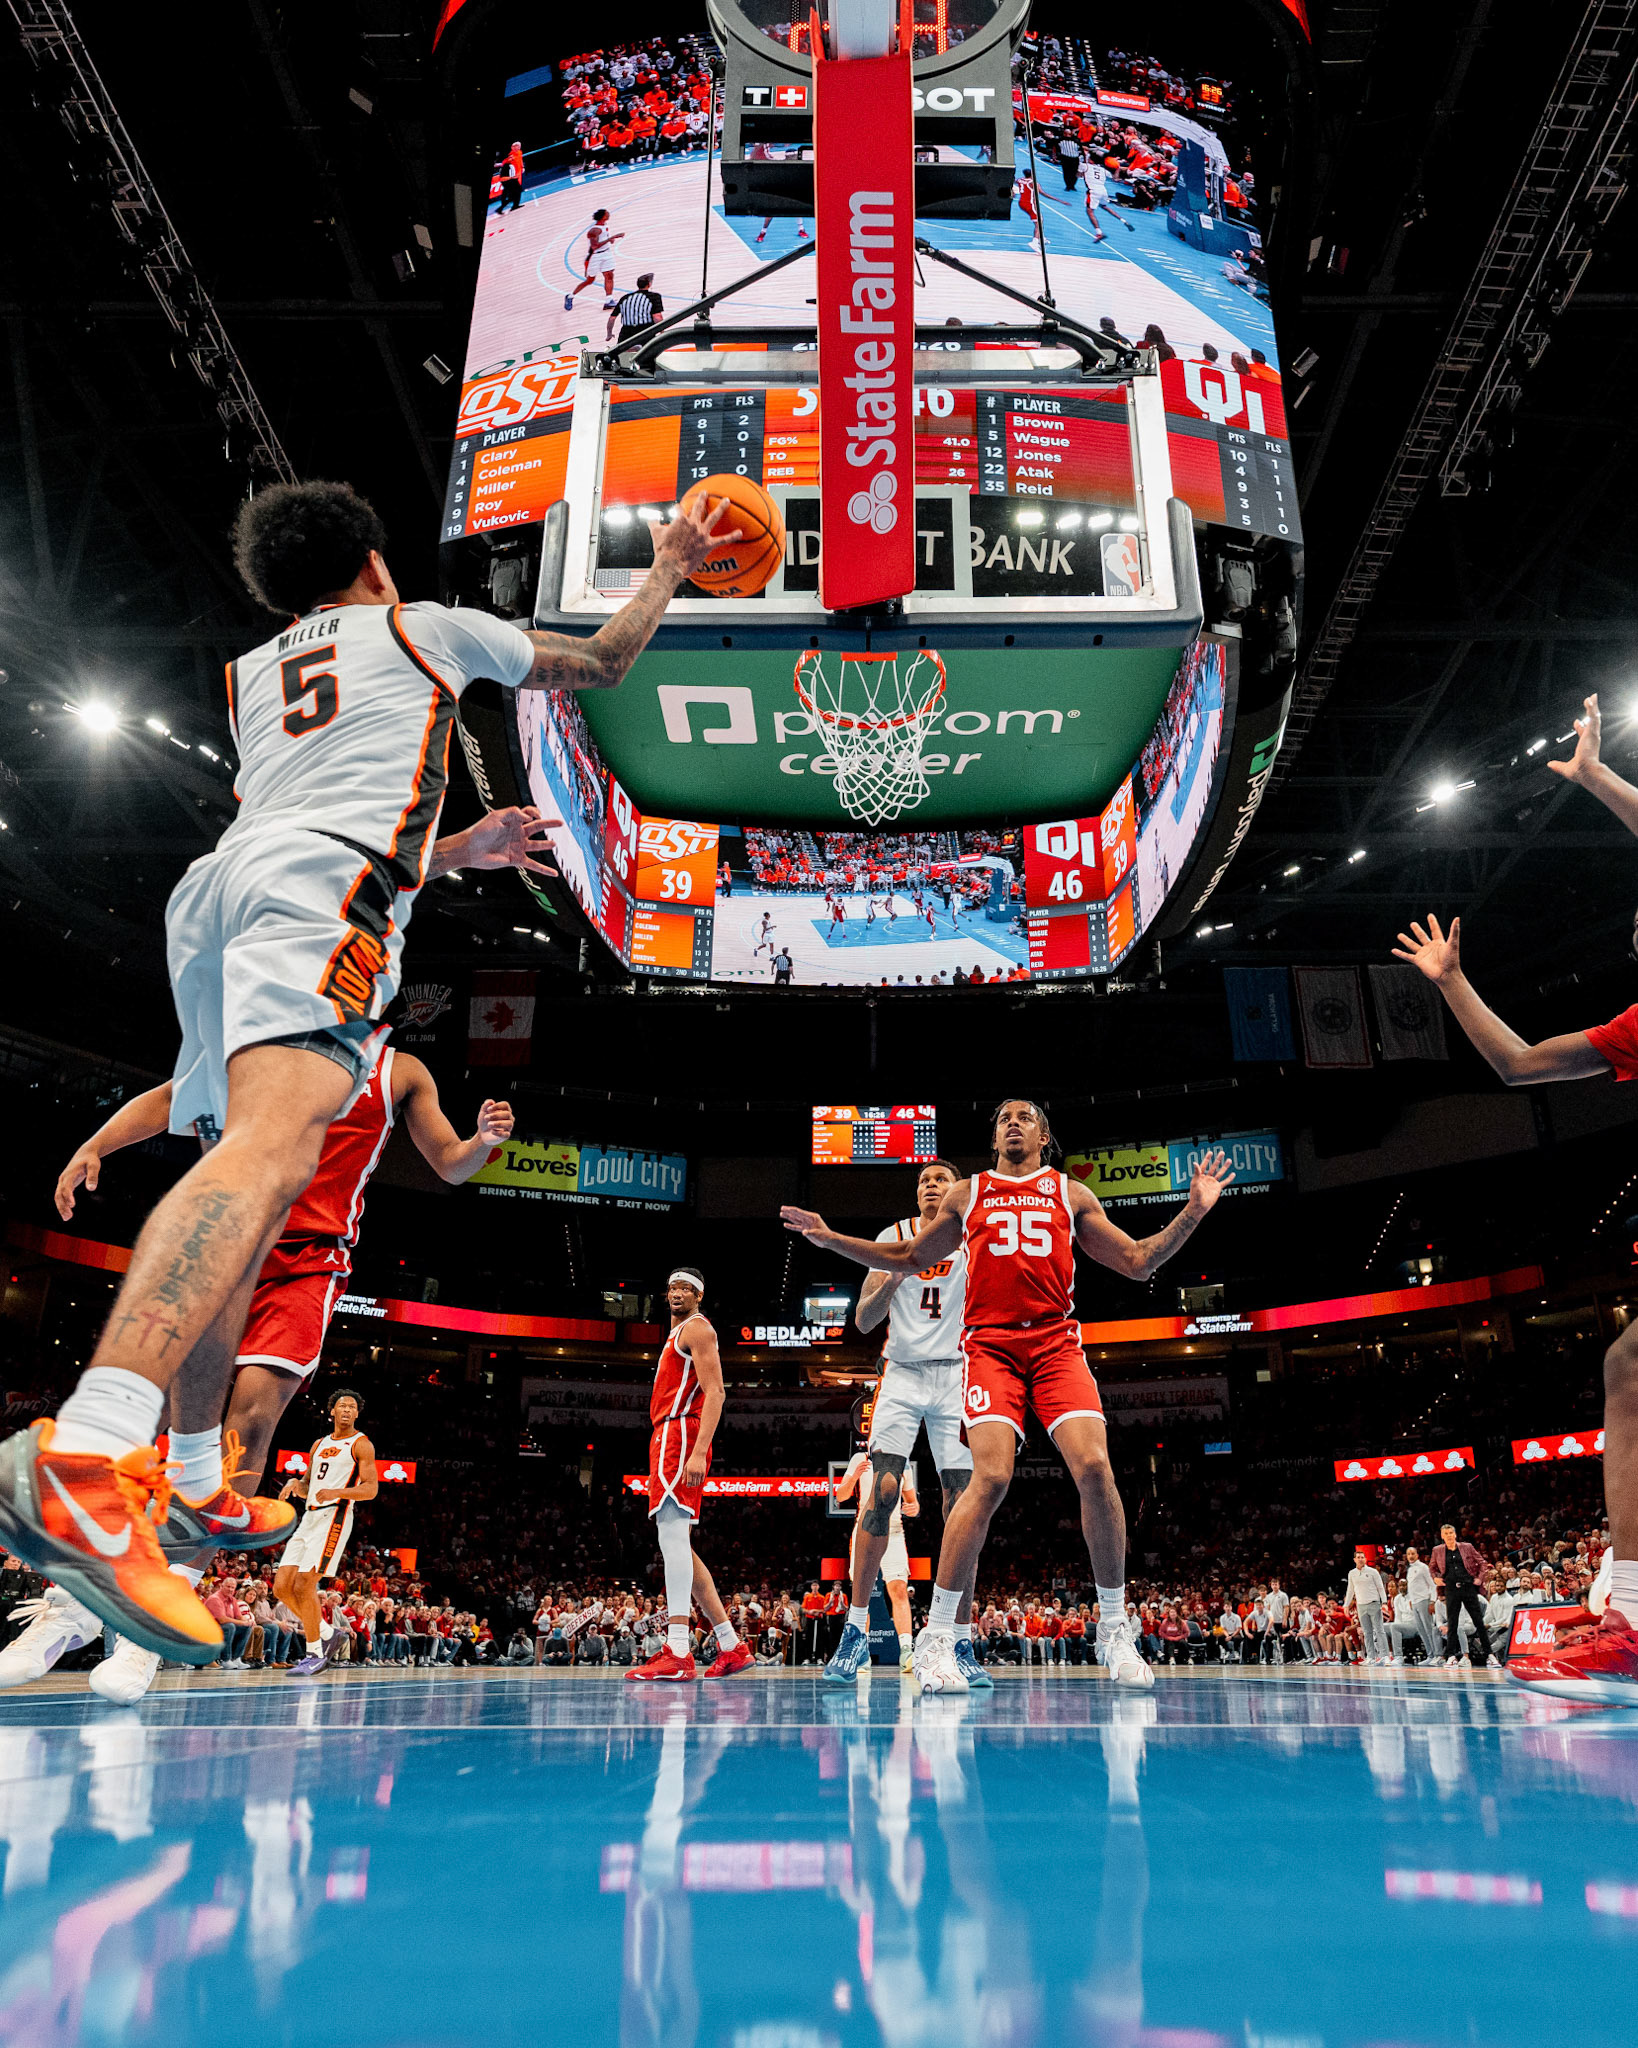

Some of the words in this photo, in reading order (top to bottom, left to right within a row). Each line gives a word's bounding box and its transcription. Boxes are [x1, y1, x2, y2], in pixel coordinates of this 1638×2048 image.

[840, 191, 896, 467] StateFarm
[693, 398, 713, 409] PTS
[735, 396, 754, 406] FLS
[1013, 398, 1061, 415] PLAYER
[697, 418, 707, 429] 8
[738, 415, 749, 425] 2
[990, 415, 997, 425] 1
[1013, 416, 1065, 430] Brown
[483, 426, 525, 447] PLAYER
[698, 434, 705, 444] 1
[737, 431, 749, 441] 0
[768, 436, 798, 446] FG%
[943, 438, 970, 447] 41.0
[988, 431, 998, 441] 5
[1013, 432, 1071, 448] Wague
[1228, 432, 1246, 444] PTS
[1265, 441, 1282, 453] FLS
[460, 460, 466, 471] 1
[480, 449, 517, 464] Clary
[696, 450, 705, 461] 7
[739, 448, 746, 458] 1
[768, 452, 787, 461] TO
[952, 452, 961, 461] 5
[985, 448, 1003, 459] 12
[1014, 449, 1062, 463] Jones
[1230, 450, 1247, 462] 10
[1271, 459, 1278, 470] 1
[456, 475, 466, 486] 4
[478, 459, 542, 480] Coleman
[691, 467, 708, 478] 13
[735, 464, 747, 475] 0
[768, 467, 794, 476] REB
[948, 468, 965, 477] 26
[985, 464, 1004, 475] 22
[1016, 466, 1054, 480] Atak
[1235, 465, 1246, 477] 4
[1274, 475, 1280, 485] 1
[454, 492, 463, 503] 5
[476, 480, 516, 497] Miller
[985, 481, 1005, 492] 35
[1016, 483, 1053, 496] Reid
[1237, 481, 1248, 493] 9
[1276, 491, 1282, 502] 1
[452, 508, 461, 520] 9
[474, 499, 503, 514] Roy
[1240, 498, 1249, 509] 3
[1278, 508, 1284, 519] 1
[447, 524, 462, 537] 19
[472, 510, 530, 530] Vukovic
[1242, 514, 1251, 526] 5
[1278, 523, 1289, 535] 0
[1109, 585, 1128, 597] NBA
[278, 618, 340, 653] MILLER
[280, 643, 339, 738] 5
[613, 840, 628, 880] 46
[1113, 840, 1127, 882] 39
[660, 869, 693, 900] 39
[1048, 869, 1083, 901] 46
[636, 901, 658, 911] PLAYER
[1029, 910, 1049, 918] PLAYER
[400, 984, 452, 1003] THUNDER
[834, 1109, 852, 1119] 39
[896, 1108, 915, 1119] 46
[1232, 1143, 1277, 1174] CITY
[583, 1158, 634, 1187] LOUD
[641, 1160, 682, 1196] CITY
[479, 1186, 516, 1198] BRING
[520, 1189, 543, 1200] THE
[545, 1192, 600, 1206] THUNDER
[616, 1200, 642, 1210] EXIT
[644, 1202, 671, 1212] NOW
[983, 1196, 1056, 1209] OKLAHOMA
[1116, 1197, 1138, 1208] THE
[1140, 1193, 1191, 1205] THUNDE
[1220, 1187, 1236, 1197] XIT
[1237, 1185, 1270, 1196] NOW
[985, 1211, 1053, 1257] 35
[333, 1301, 385, 1318] StateFarm
[920, 1287, 941, 1319] 4
[754, 1326, 826, 1341] BEDLAM
[1200, 1321, 1252, 1334] StateFarm
[1132, 1391, 1165, 1403] PARTY
[1169, 1388, 1217, 1401] TERRACE
[317, 1462, 329, 1480] 9
[720, 1481, 772, 1493] StateFarm
